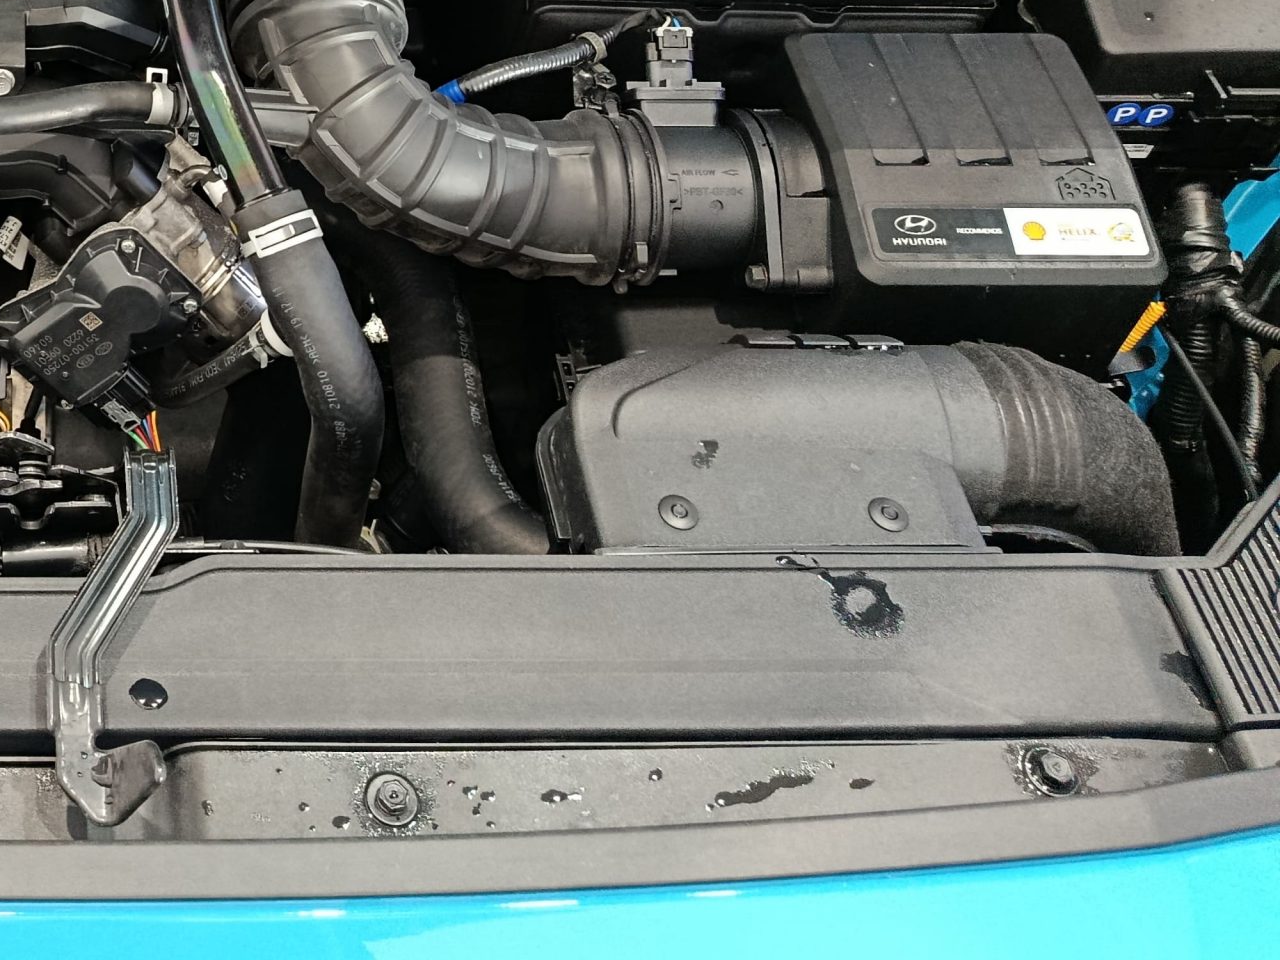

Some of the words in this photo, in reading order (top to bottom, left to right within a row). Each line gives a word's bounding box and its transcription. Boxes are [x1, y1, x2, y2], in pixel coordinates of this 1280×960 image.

[1113, 107, 1136, 123] P
[1145, 108, 1168, 124] P
[956, 227, 1003, 235] RECOMMENDS
[892, 237, 947, 247] HYUNDAI
[317, 370, 341, 410] 210810
